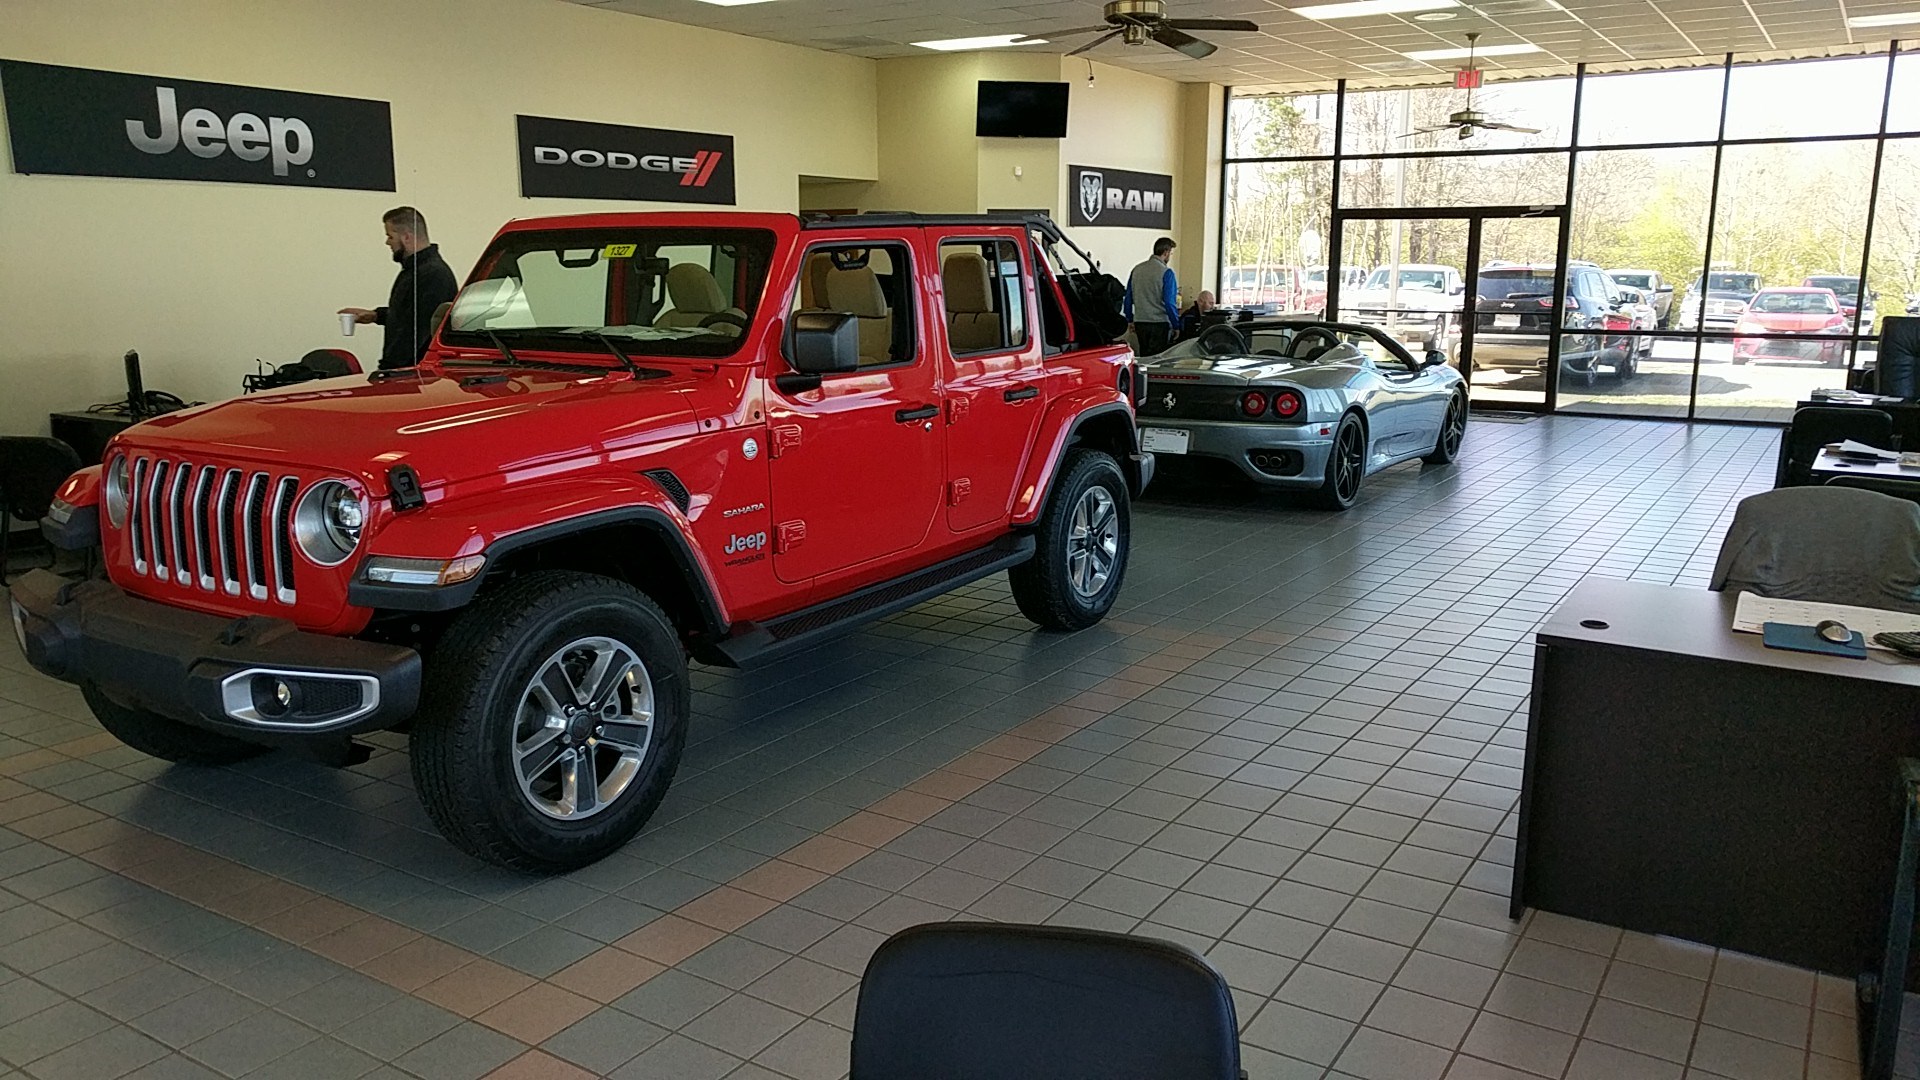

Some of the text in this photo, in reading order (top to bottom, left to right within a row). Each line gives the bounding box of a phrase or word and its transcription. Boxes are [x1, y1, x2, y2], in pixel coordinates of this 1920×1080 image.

[125, 86, 314, 177] Jeep
[534, 146, 699, 173] DODGE
[1106, 187, 1164, 212] RAM
[610, 246, 631, 256] 1327
[723, 502, 766, 518] SAHARA
[724, 531, 767, 555] Jeep
